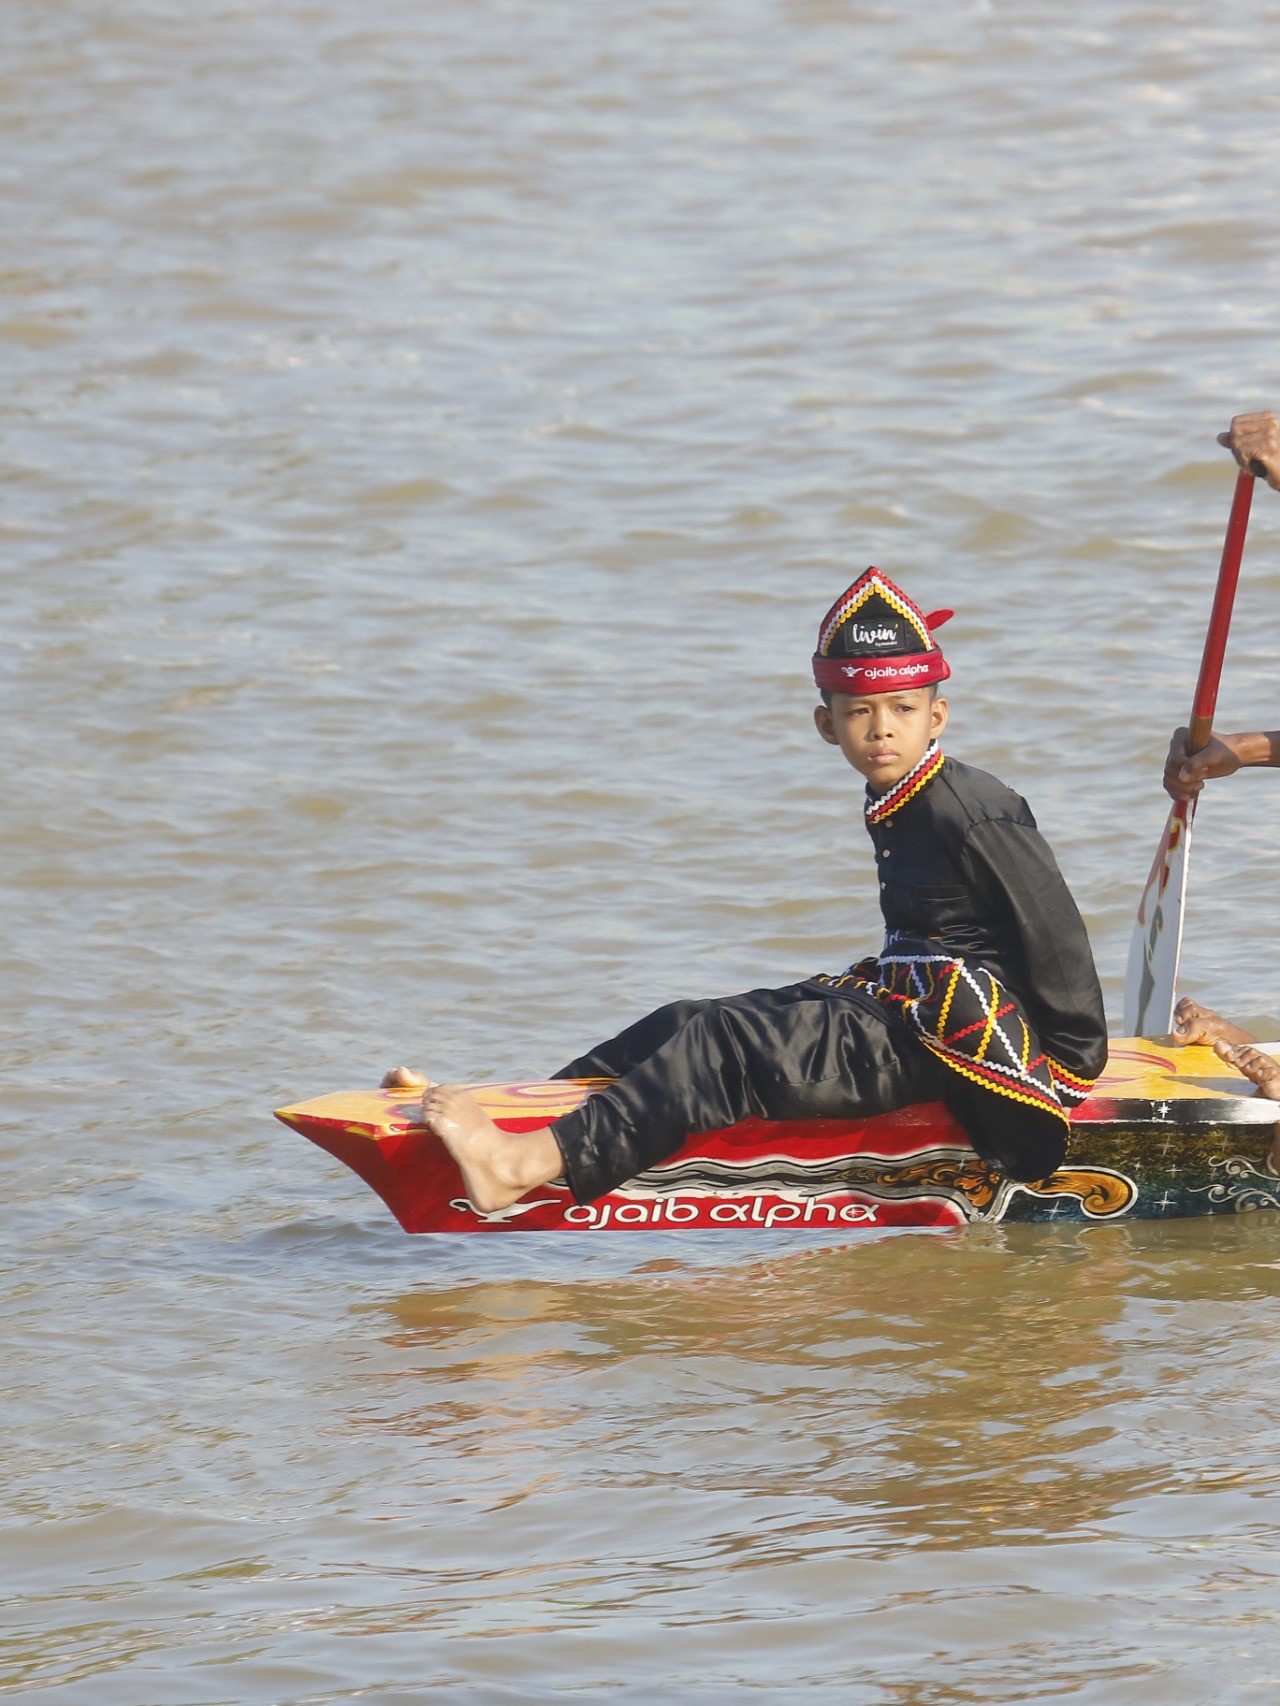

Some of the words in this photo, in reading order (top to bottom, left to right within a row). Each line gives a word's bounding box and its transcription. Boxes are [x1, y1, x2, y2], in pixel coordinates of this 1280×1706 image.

[864, 666, 898, 680] ajaib
[899, 663, 929, 677] alpha
[563, 1197, 699, 1230] ajaib
[709, 1197, 880, 1228] alpha
